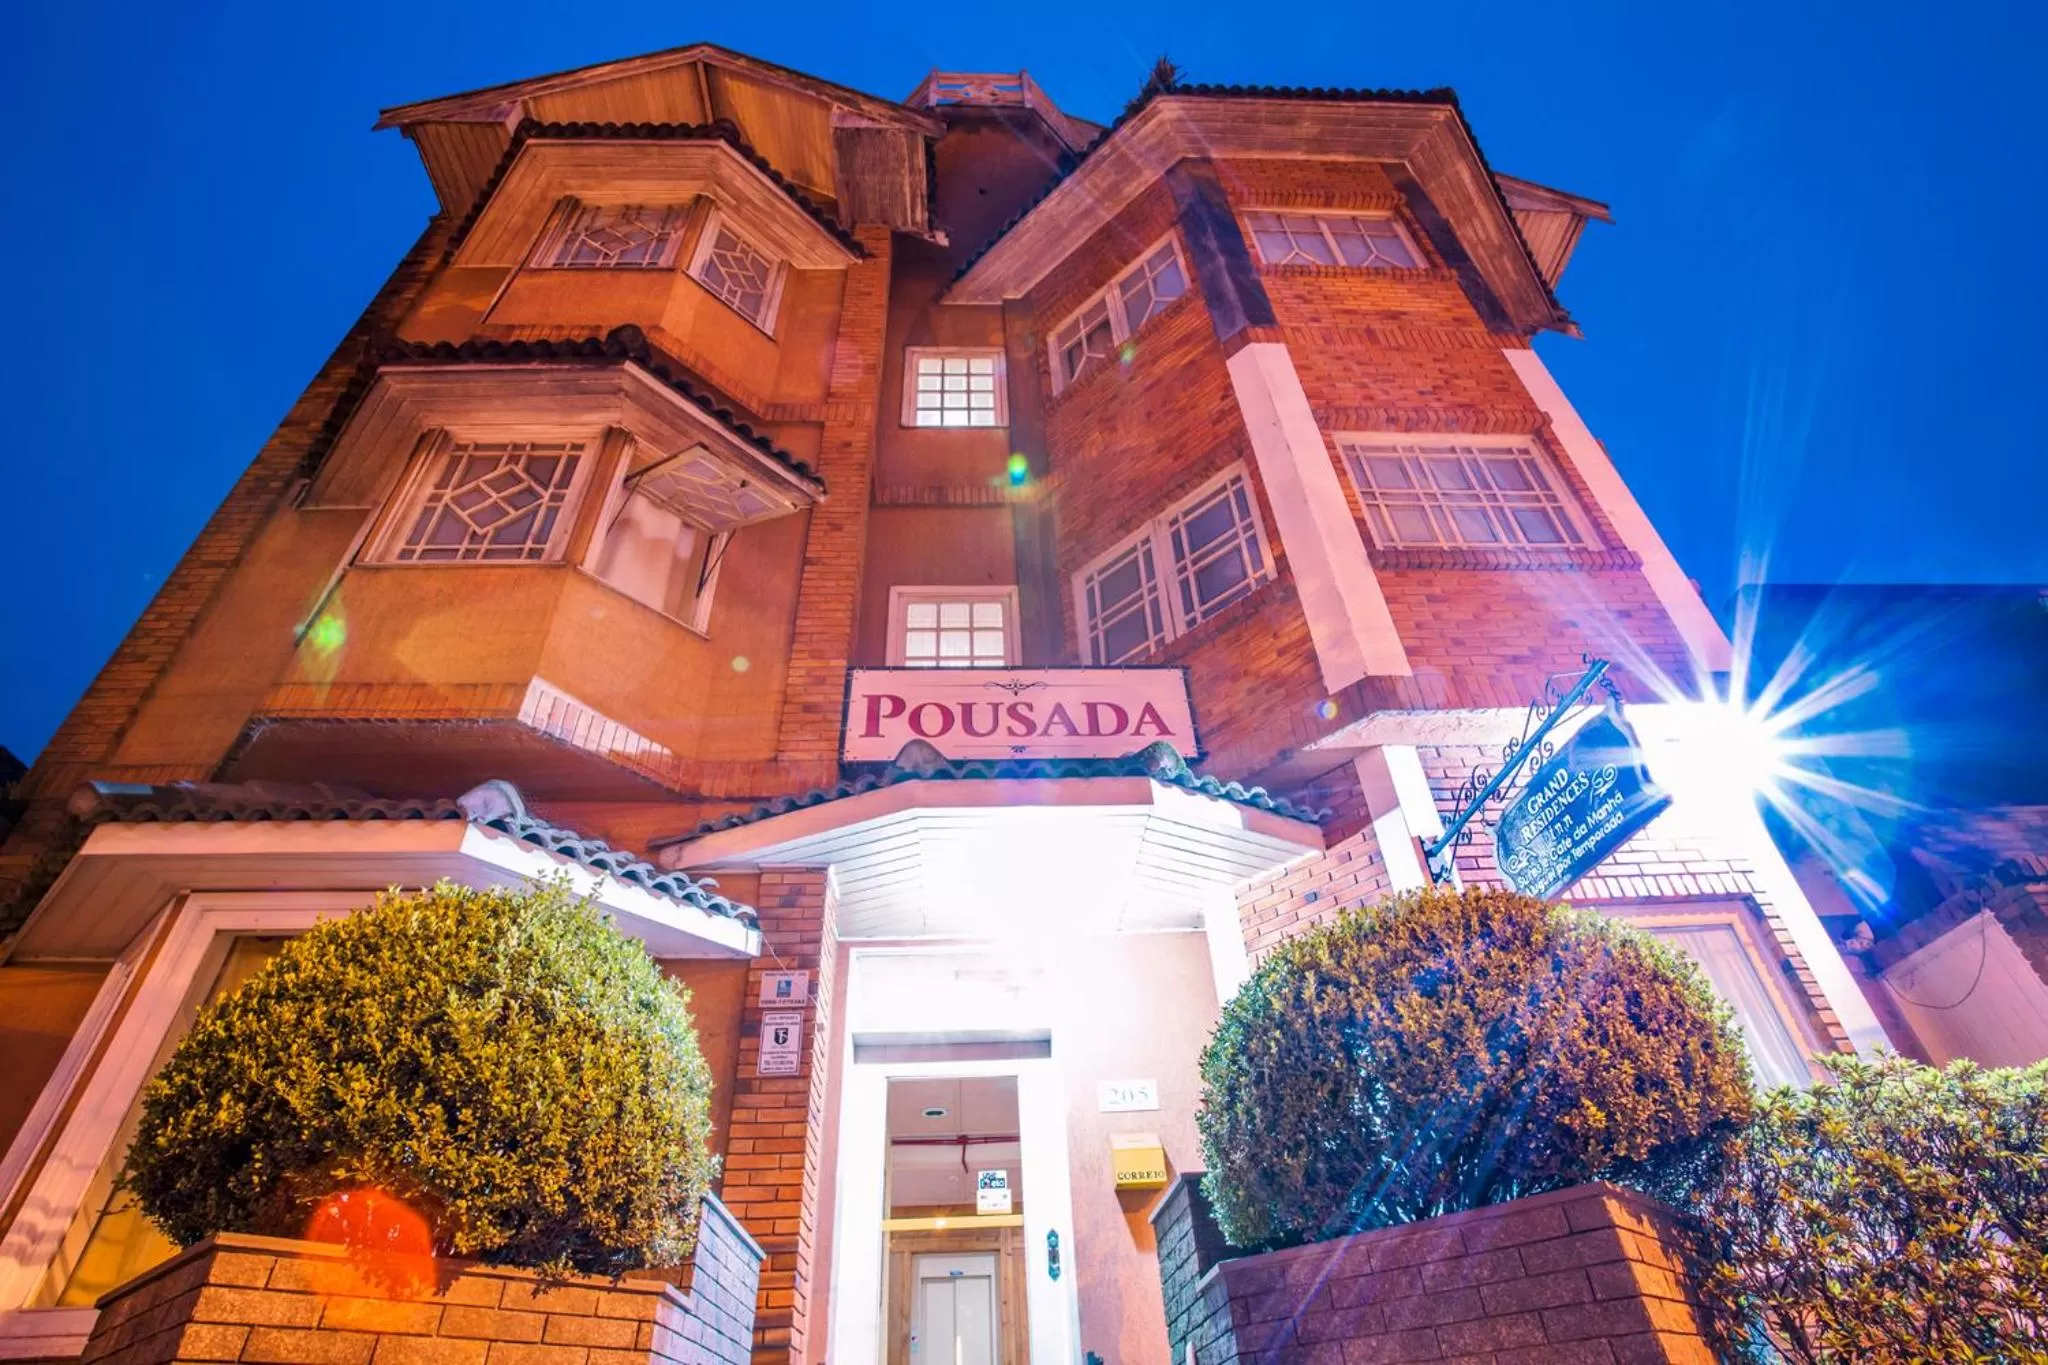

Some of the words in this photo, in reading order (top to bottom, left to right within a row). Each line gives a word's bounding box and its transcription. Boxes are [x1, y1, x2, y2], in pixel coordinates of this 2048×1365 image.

[859, 694, 1176, 738] POUSADA
[1520, 771, 1589, 844] RESIDENCES
[1527, 768, 1569, 815] GRAND
[1573, 823, 1588, 840] da
[1586, 789, 1624, 829] Manhã
[1571, 811, 1624, 861] Temporada
[1108, 1086, 1149, 1105] 205
[1117, 1171, 1165, 1181] CORREIO
